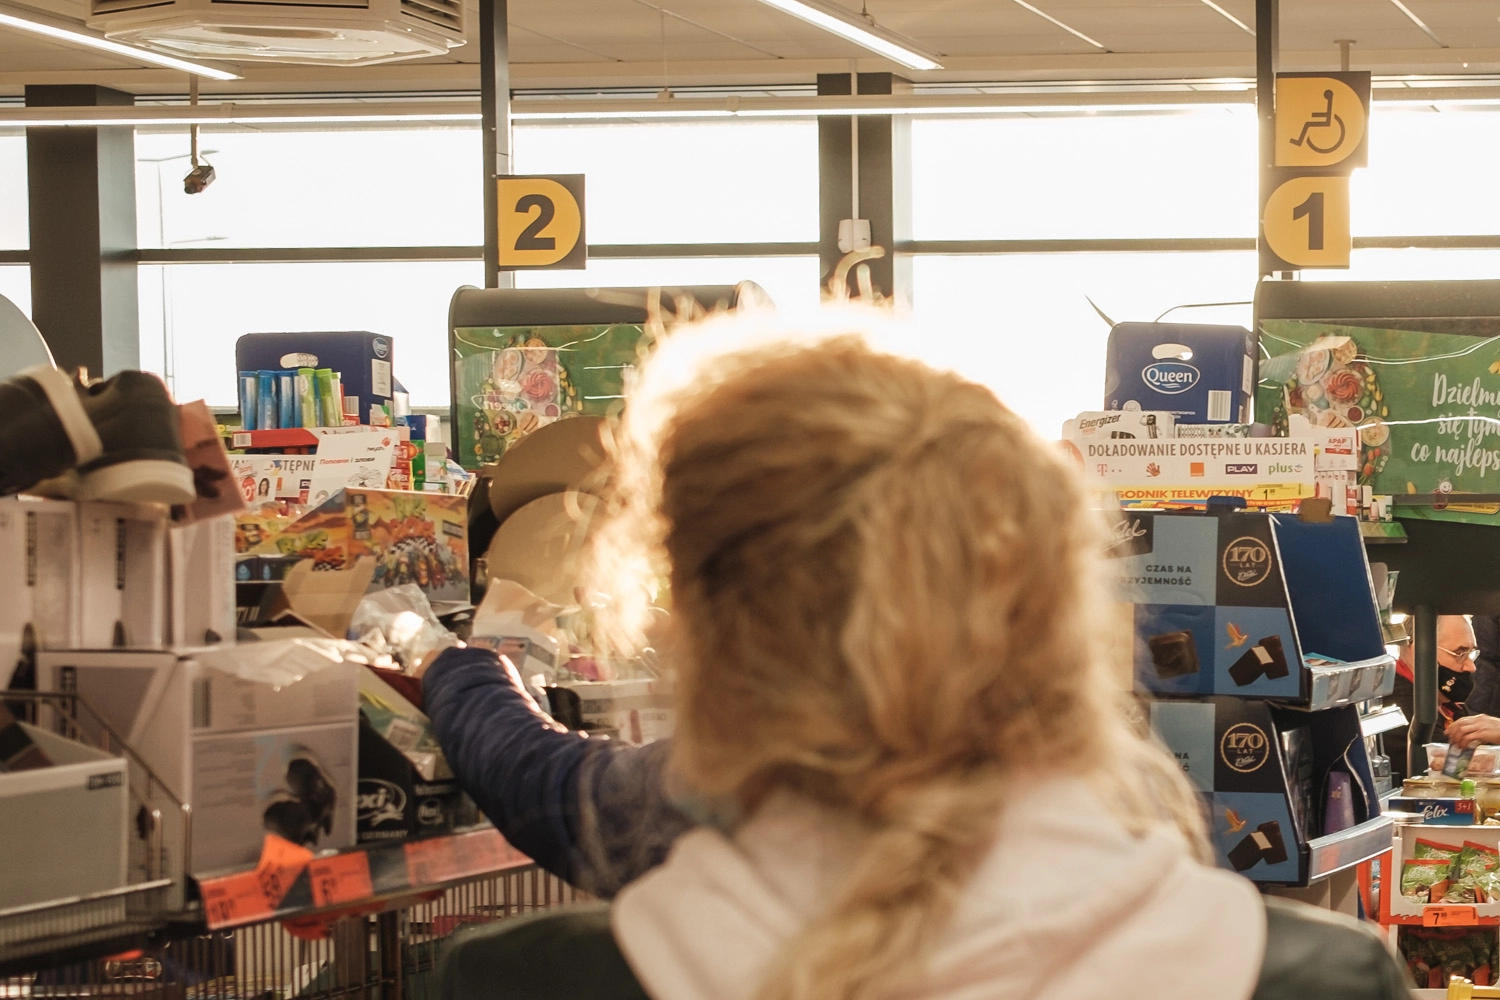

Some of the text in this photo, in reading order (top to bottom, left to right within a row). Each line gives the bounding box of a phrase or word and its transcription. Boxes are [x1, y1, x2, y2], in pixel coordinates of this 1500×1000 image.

[514, 195, 556, 251] 2
[1293, 192, 1324, 250] 1
[1146, 368, 1193, 386] Queen
[1079, 414, 1121, 429] Energizer
[1438, 414, 1464, 440] się
[1089, 442, 1307, 459] DOŁADOWANIE DOSTĘPNE U KASJERA
[1411, 443, 1431, 462] co
[1227, 465, 1256, 473] PLAY
[1269, 463, 1293, 475] plus
[1116, 490, 1168, 498] GODNIK
[1229, 547, 1266, 562] 170
[1145, 564, 1192, 573] CZAS NA
[1119, 576, 1192, 586] RZYJEMNOŚĆ
[1228, 733, 1264, 749] 170
[1421, 805, 1450, 820] felix
[1433, 913, 1440, 925] 7
